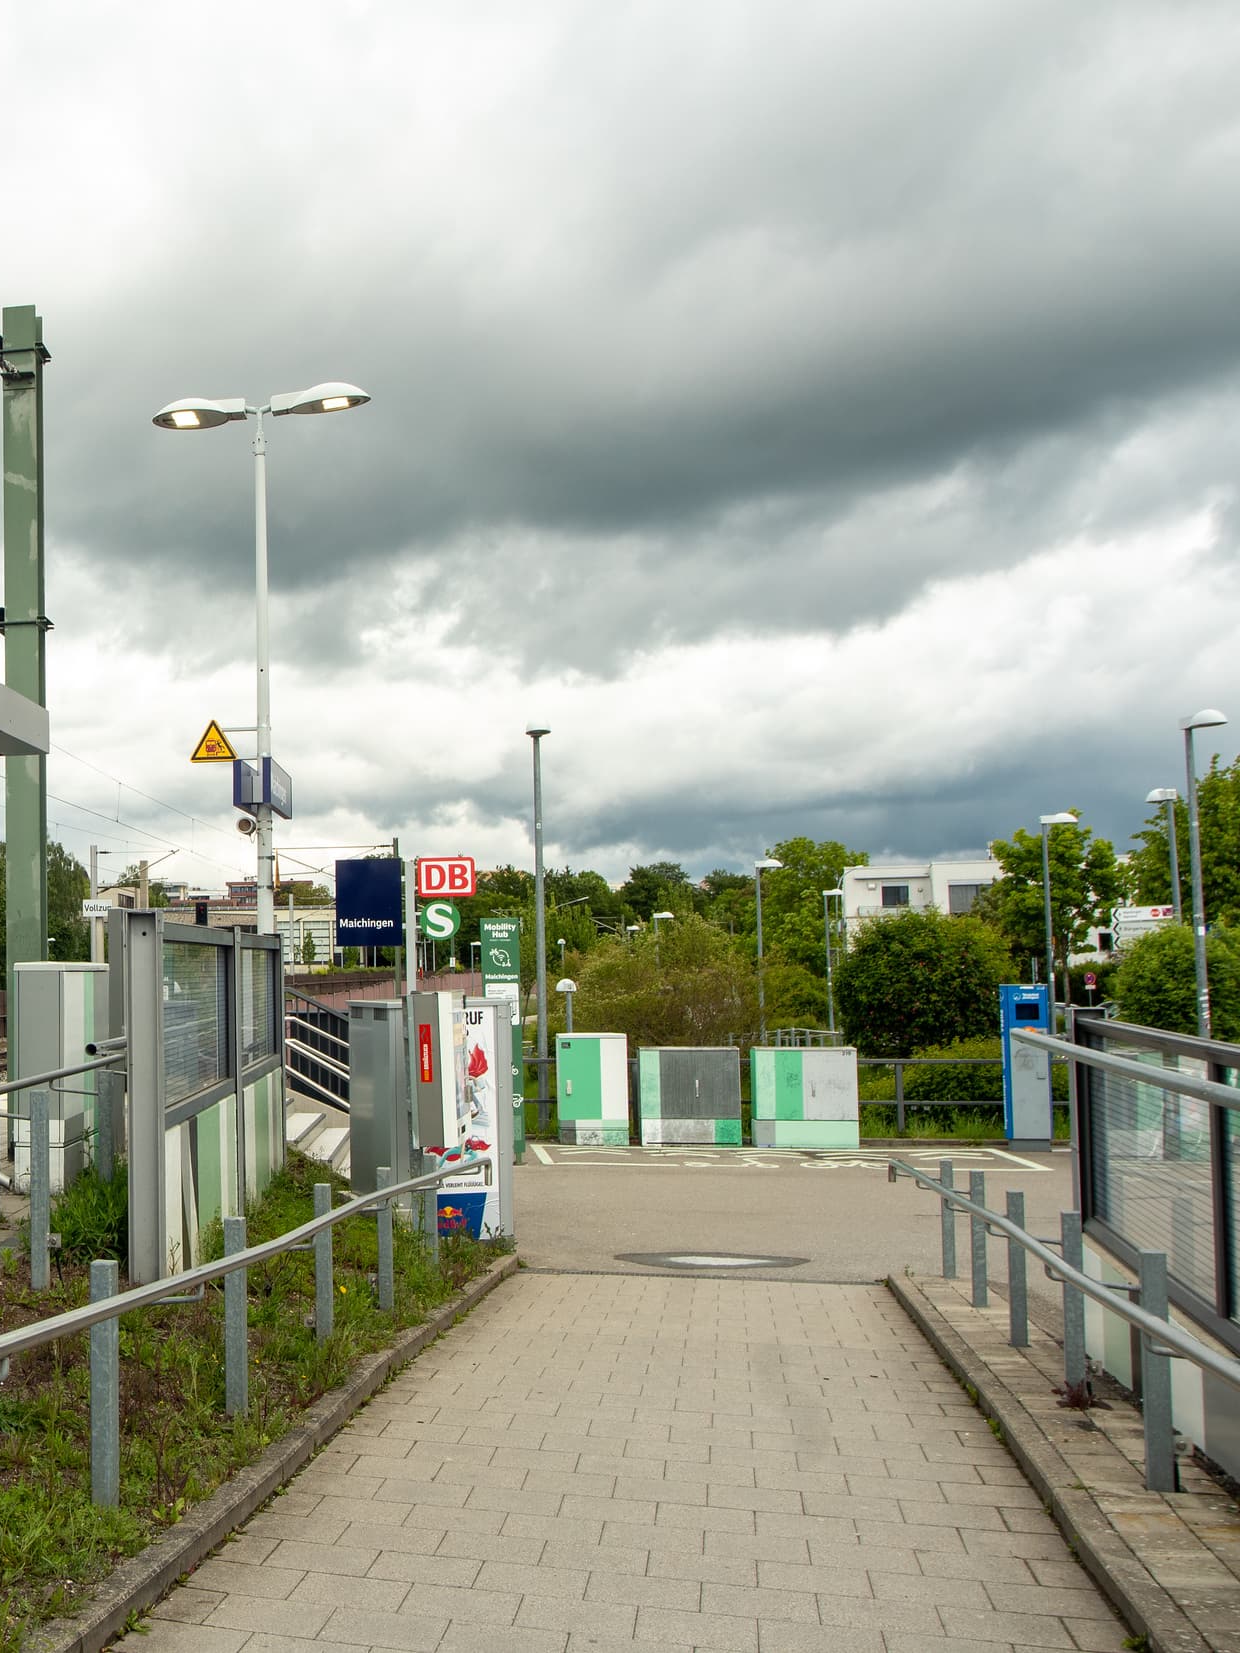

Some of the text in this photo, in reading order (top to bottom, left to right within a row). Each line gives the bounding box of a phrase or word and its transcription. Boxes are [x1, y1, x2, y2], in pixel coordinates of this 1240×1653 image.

[425, 864, 469, 890] DB
[339, 918, 394, 930] Maichingen
[426, 903, 454, 938] S
[484, 923, 516, 932] Mobility
